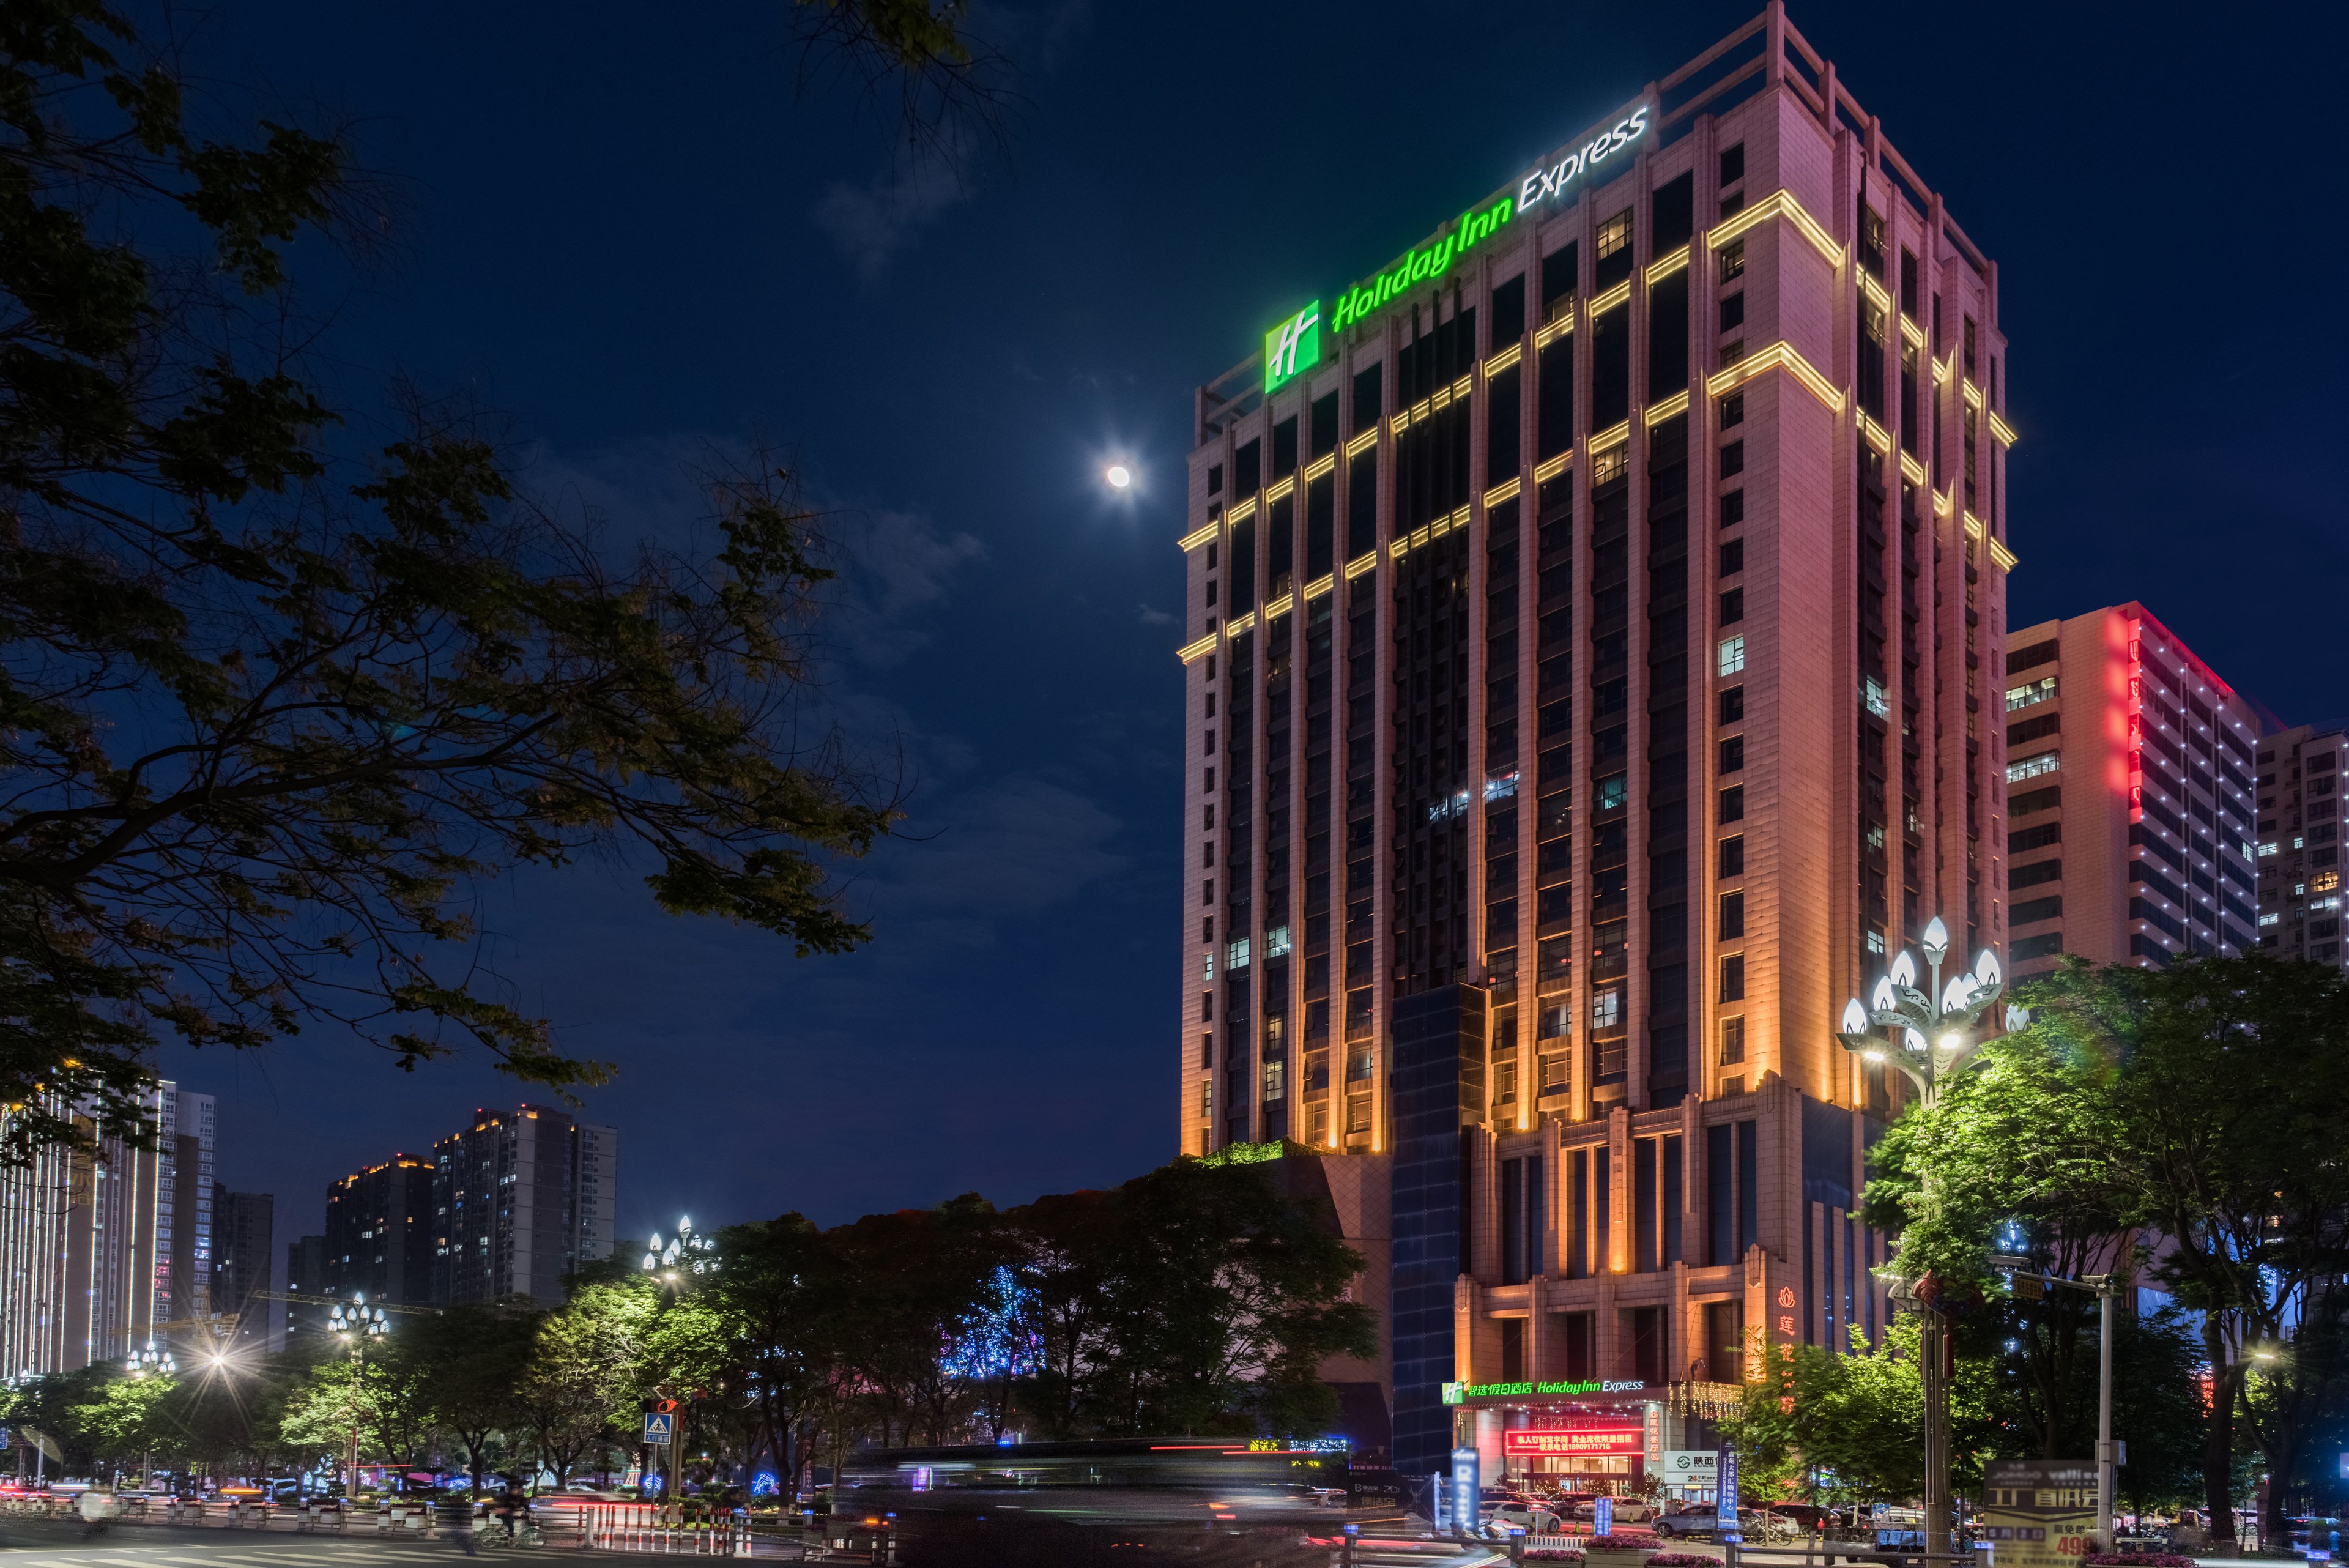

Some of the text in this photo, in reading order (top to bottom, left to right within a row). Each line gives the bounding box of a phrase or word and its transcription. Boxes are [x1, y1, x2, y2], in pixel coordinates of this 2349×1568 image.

[1332, 106, 1649, 333] Holiday Inn Express
[1468, 1380, 1644, 1397] 智选假日酒店 Holiday Inn Express
